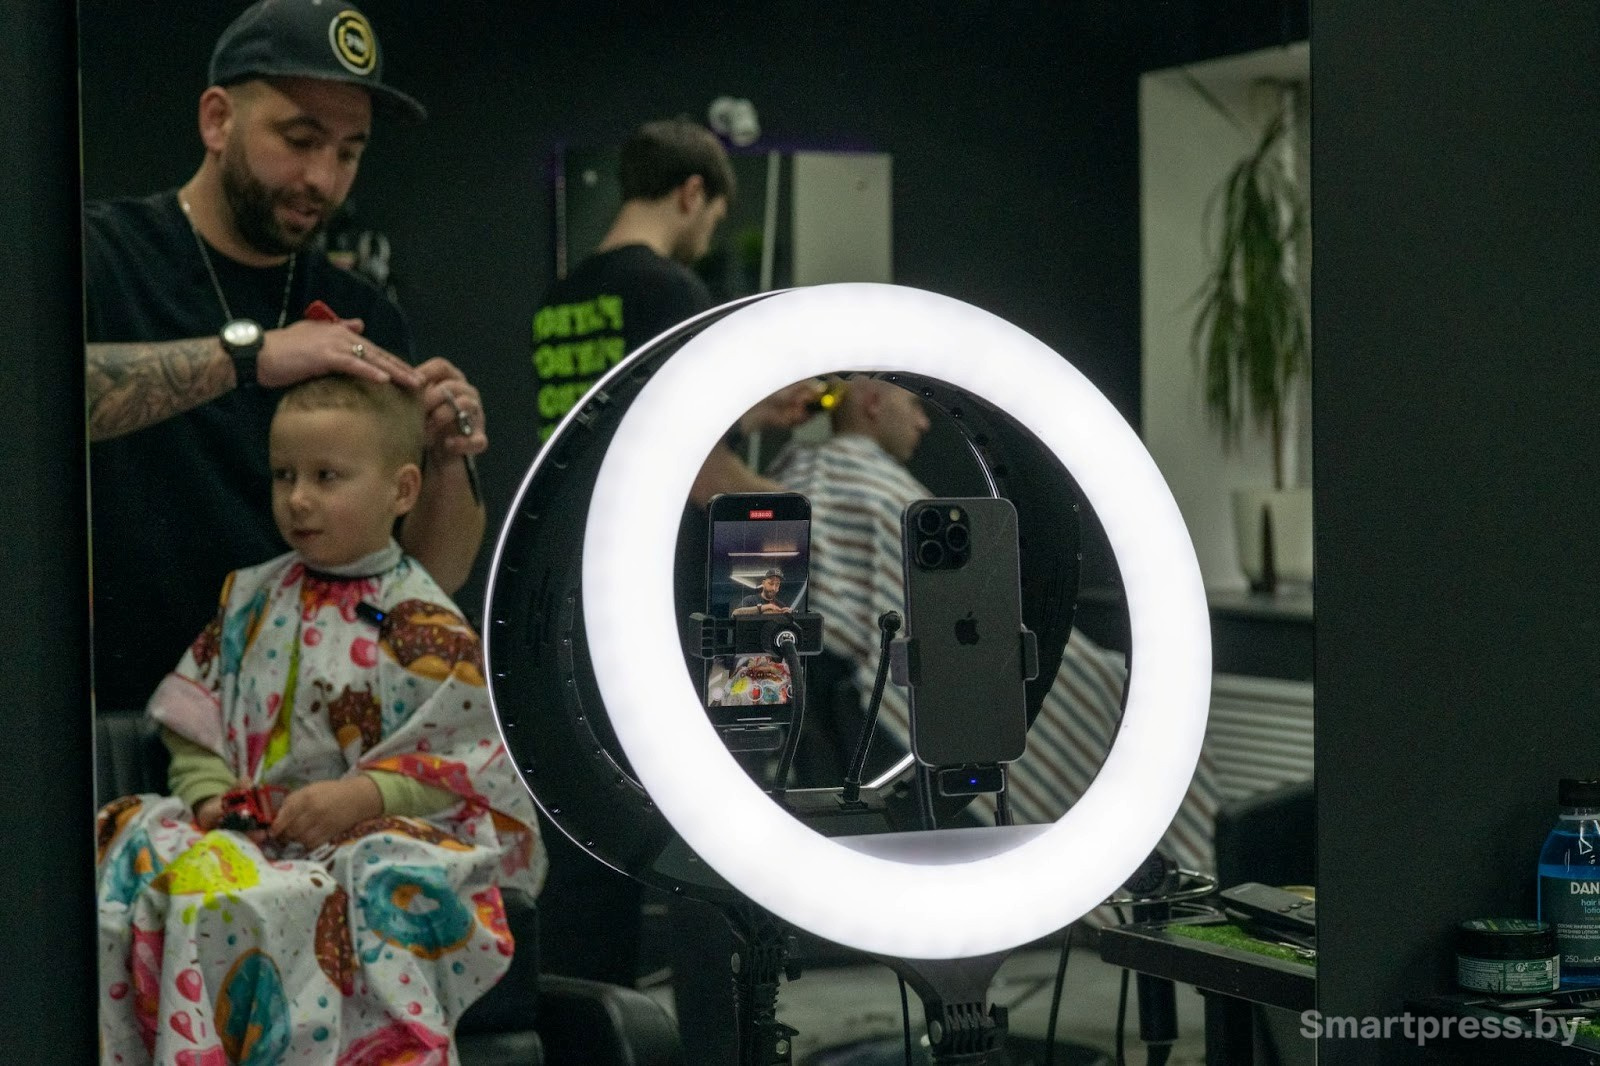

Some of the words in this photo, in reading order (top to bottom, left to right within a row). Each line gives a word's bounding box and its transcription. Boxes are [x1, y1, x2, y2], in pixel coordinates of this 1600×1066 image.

[1570, 881, 1600, 895] DAN
[1581, 898, 1597, 906] hair
[1565, 955, 1579, 963] 250
